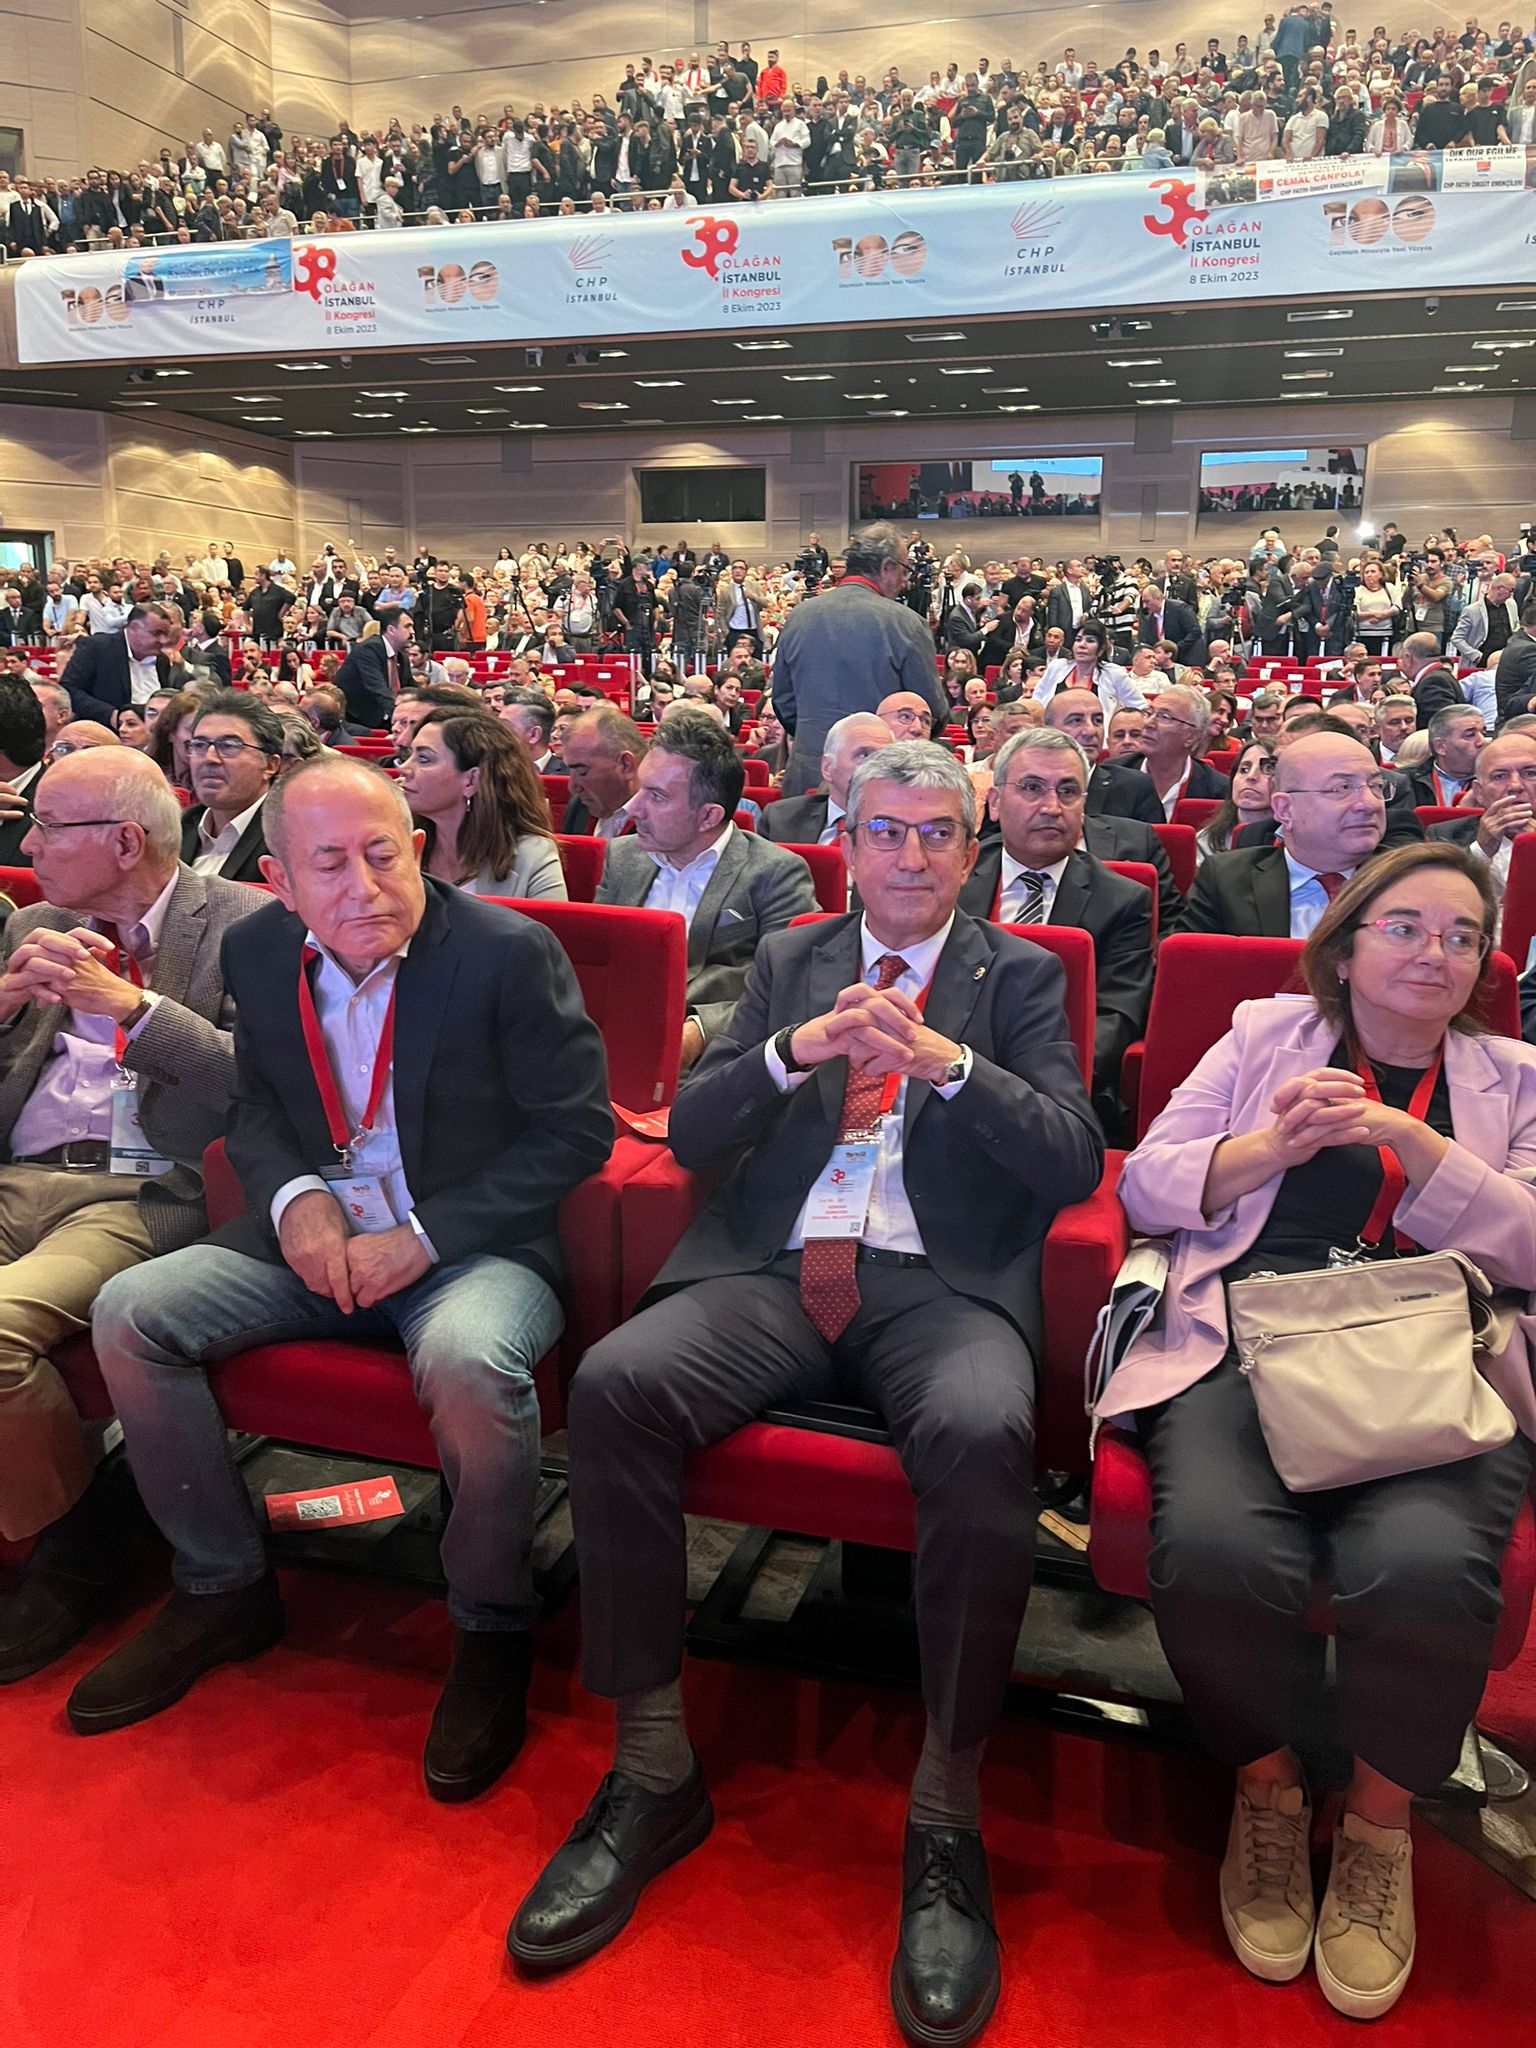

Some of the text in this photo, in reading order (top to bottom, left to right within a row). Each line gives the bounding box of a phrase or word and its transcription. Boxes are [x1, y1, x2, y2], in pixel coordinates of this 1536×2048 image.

[1192, 220, 1262, 236] OLAĞAN
[1191, 238, 1261, 252] İSTANBUL
[1017, 246, 1054, 259] CHP
[722, 255, 781, 268] OLAĞAN
[1202, 254, 1260, 268] Kongresi
[1004, 264, 1066, 276] İSTANBUL
[576, 277, 608, 288] CHP
[722, 272, 782, 284] İSTANBUL
[1189, 272, 1258, 284] 8 Ekim 2023
[324, 280, 375, 293] OLAĞAN
[732, 286, 781, 298] Kongresi
[197, 299, 225, 310] CHP
[324, 296, 376, 307] İSTANBUL
[566, 293, 618, 304] İSTANBUL
[722, 302, 781, 314] 8 Ekim 2023
[190, 314, 236, 324] İSTANBUL
[334, 309, 376, 321] Kongresi
[334, 326, 354, 334] Ekim
[356, 324, 377, 334] 2023
